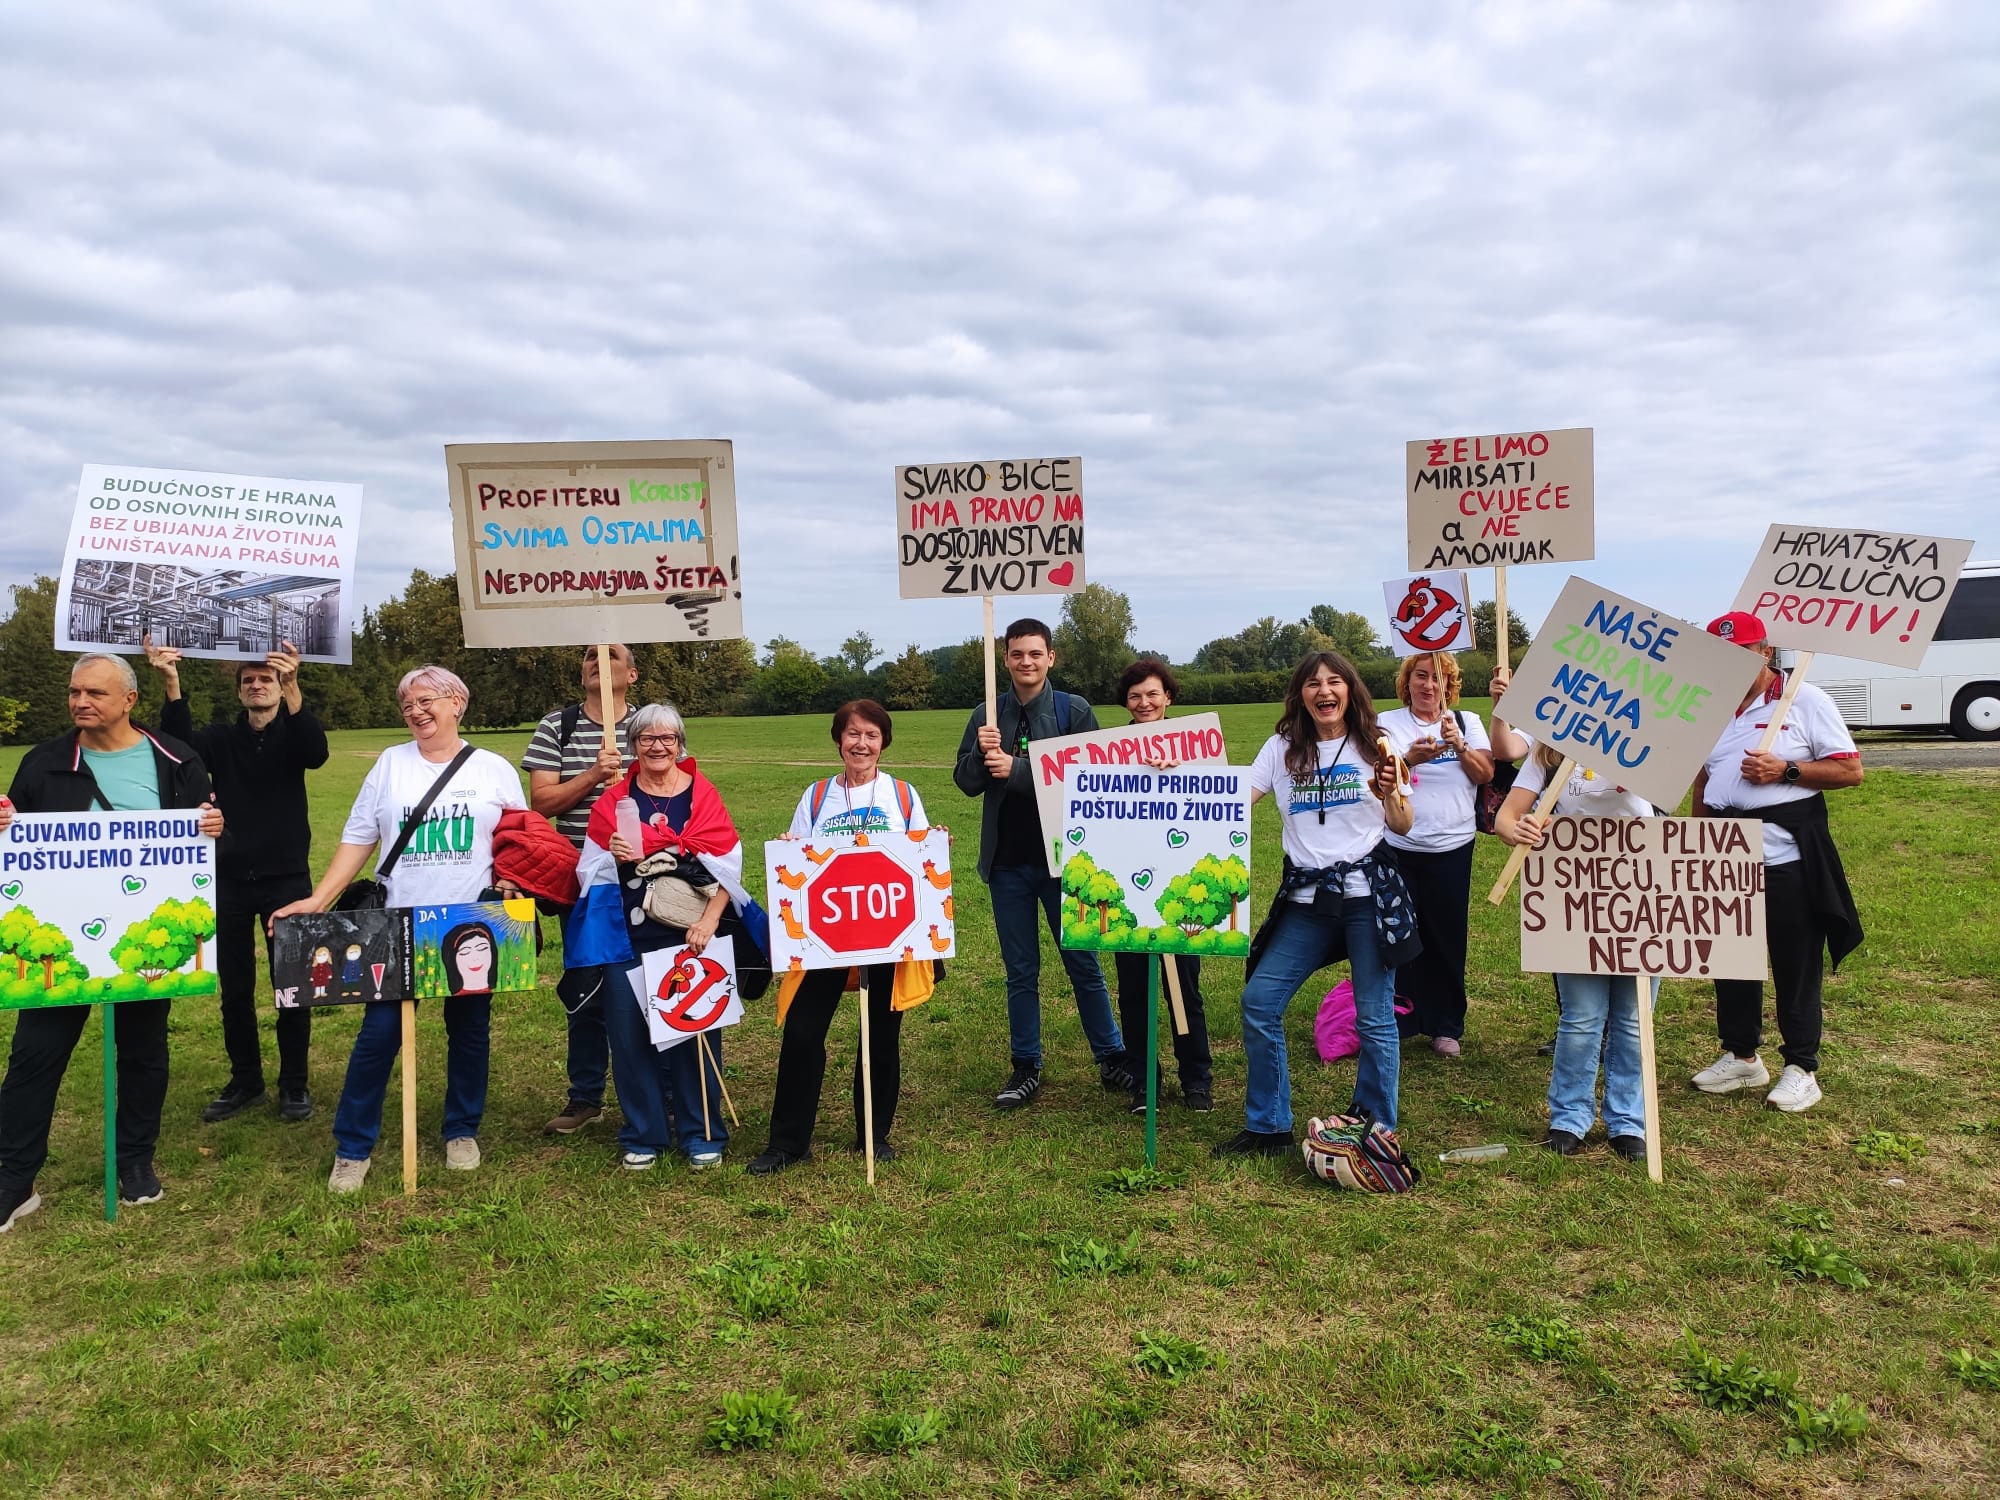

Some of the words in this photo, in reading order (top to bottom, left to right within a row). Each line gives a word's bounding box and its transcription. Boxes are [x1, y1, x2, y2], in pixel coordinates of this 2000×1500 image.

[1426, 433, 1549, 467] ŽELIMO
[103, 477, 235, 501] BUDUĆNOST
[239, 487, 259, 502] JE
[265, 490, 336, 508] HRANA
[903, 463, 986, 500] SVAKO
[999, 459, 1074, 491] BIĆE
[1414, 461, 1535, 492] MIRISATI
[477, 483, 620, 510] PROFITERU
[629, 478, 707, 510] KORIST,
[1459, 482, 1570, 516] CVIJEĆE
[89, 497, 120, 511] OD
[126, 499, 239, 520] OSNOVNIH
[244, 508, 344, 529] SIROVINA
[911, 499, 959, 530] IMA
[969, 493, 1045, 524] PRAVO
[1053, 493, 1083, 522] NA
[1481, 514, 1521, 539] NE
[89, 516, 128, 532] BEZ
[134, 519, 228, 539] UBIJANJA
[232, 523, 337, 548] ŽIVOTINJA
[482, 522, 569, 550] SVIMA
[581, 515, 704, 545] OSTALIMA
[901, 524, 1083, 566] DOSTOJANSTVEN
[79, 535, 85, 549] I
[91, 536, 232, 560] UNIŠTAVANJA
[239, 547, 340, 569] PRAŠUMA
[1424, 538, 1554, 569] AMONIJAK
[1772, 530, 1939, 570] HRVATSKA
[941, 559, 1050, 593] ŽIVOT
[1773, 561, 1946, 603] ODLUČNO
[1584, 599, 1679, 662] NAŠE
[1551, 623, 1712, 723] ZDRAVLJE
[1551, 663, 1640, 730] NEMA
[1086, 728, 1223, 765] DOPUSTIMO
[1535, 695, 1651, 768] CIJENU
[1077, 770, 1151, 793] ČUVAMO
[1158, 775, 1238, 795] PRIRODU
[403, 805, 446, 824] HDAJ
[1070, 796, 1178, 820] POŠTUJEMO
[1183, 798, 1244, 822] ŽIVOTE
[10, 820, 100, 843] ČUVAMO
[109, 819, 200, 840] PRIRODU
[1662, 820, 1751, 855] PLIVA
[3, 847, 132, 872] POŠTUJEMO
[139, 843, 208, 866] ŽIVOTE
[1524, 855, 1544, 887] U
[1554, 854, 1662, 896] SMEĆU,
[1671, 859, 1765, 897] FEKALIJE
[821, 882, 907, 924] STOP
[1523, 890, 1546, 932] S
[1564, 891, 1753, 937] MEGAFARMI
[1588, 934, 1713, 975] NEĆU!
[275, 986, 300, 1009] NE
